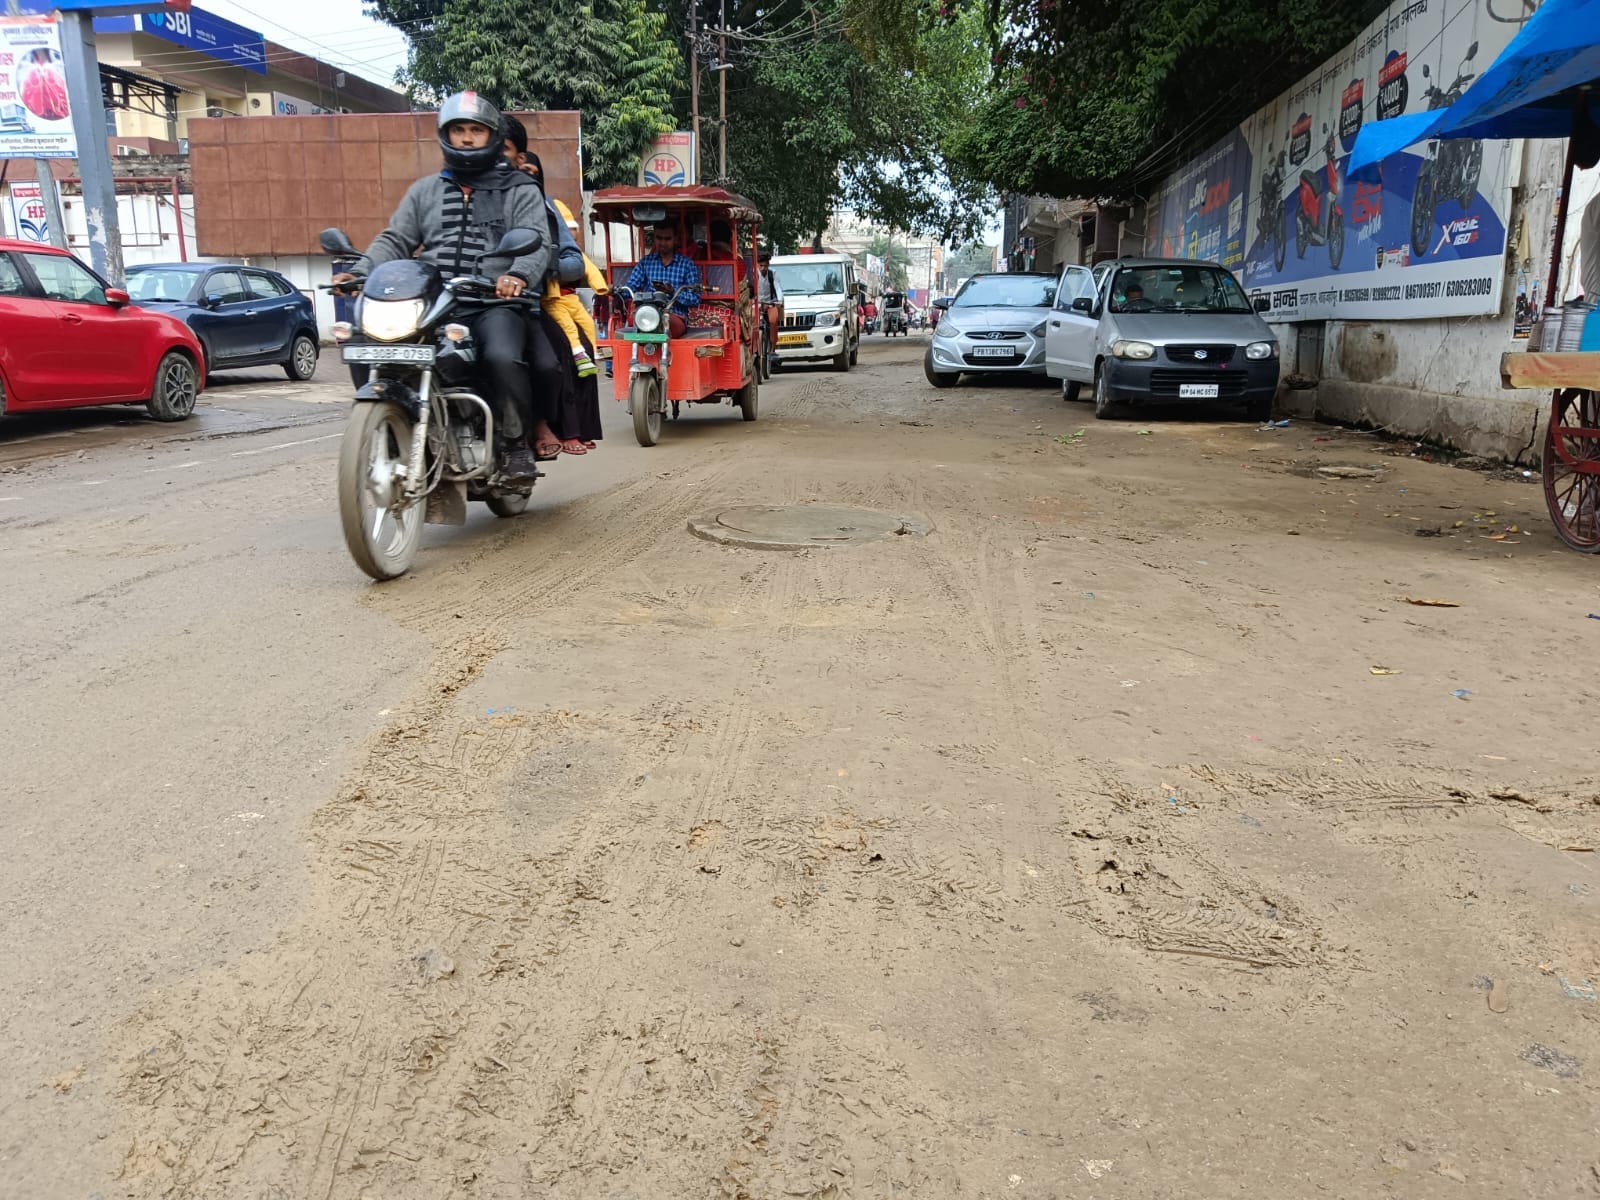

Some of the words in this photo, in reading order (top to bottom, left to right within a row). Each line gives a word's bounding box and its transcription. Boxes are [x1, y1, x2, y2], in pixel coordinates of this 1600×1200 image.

[165, 11, 192, 38] SBI
[285, 103, 298, 115] SBI
[654, 159, 676, 172] HP
[1273, 288, 1298, 308] सन्स
[1446, 277, 1492, 297] 6306283009
